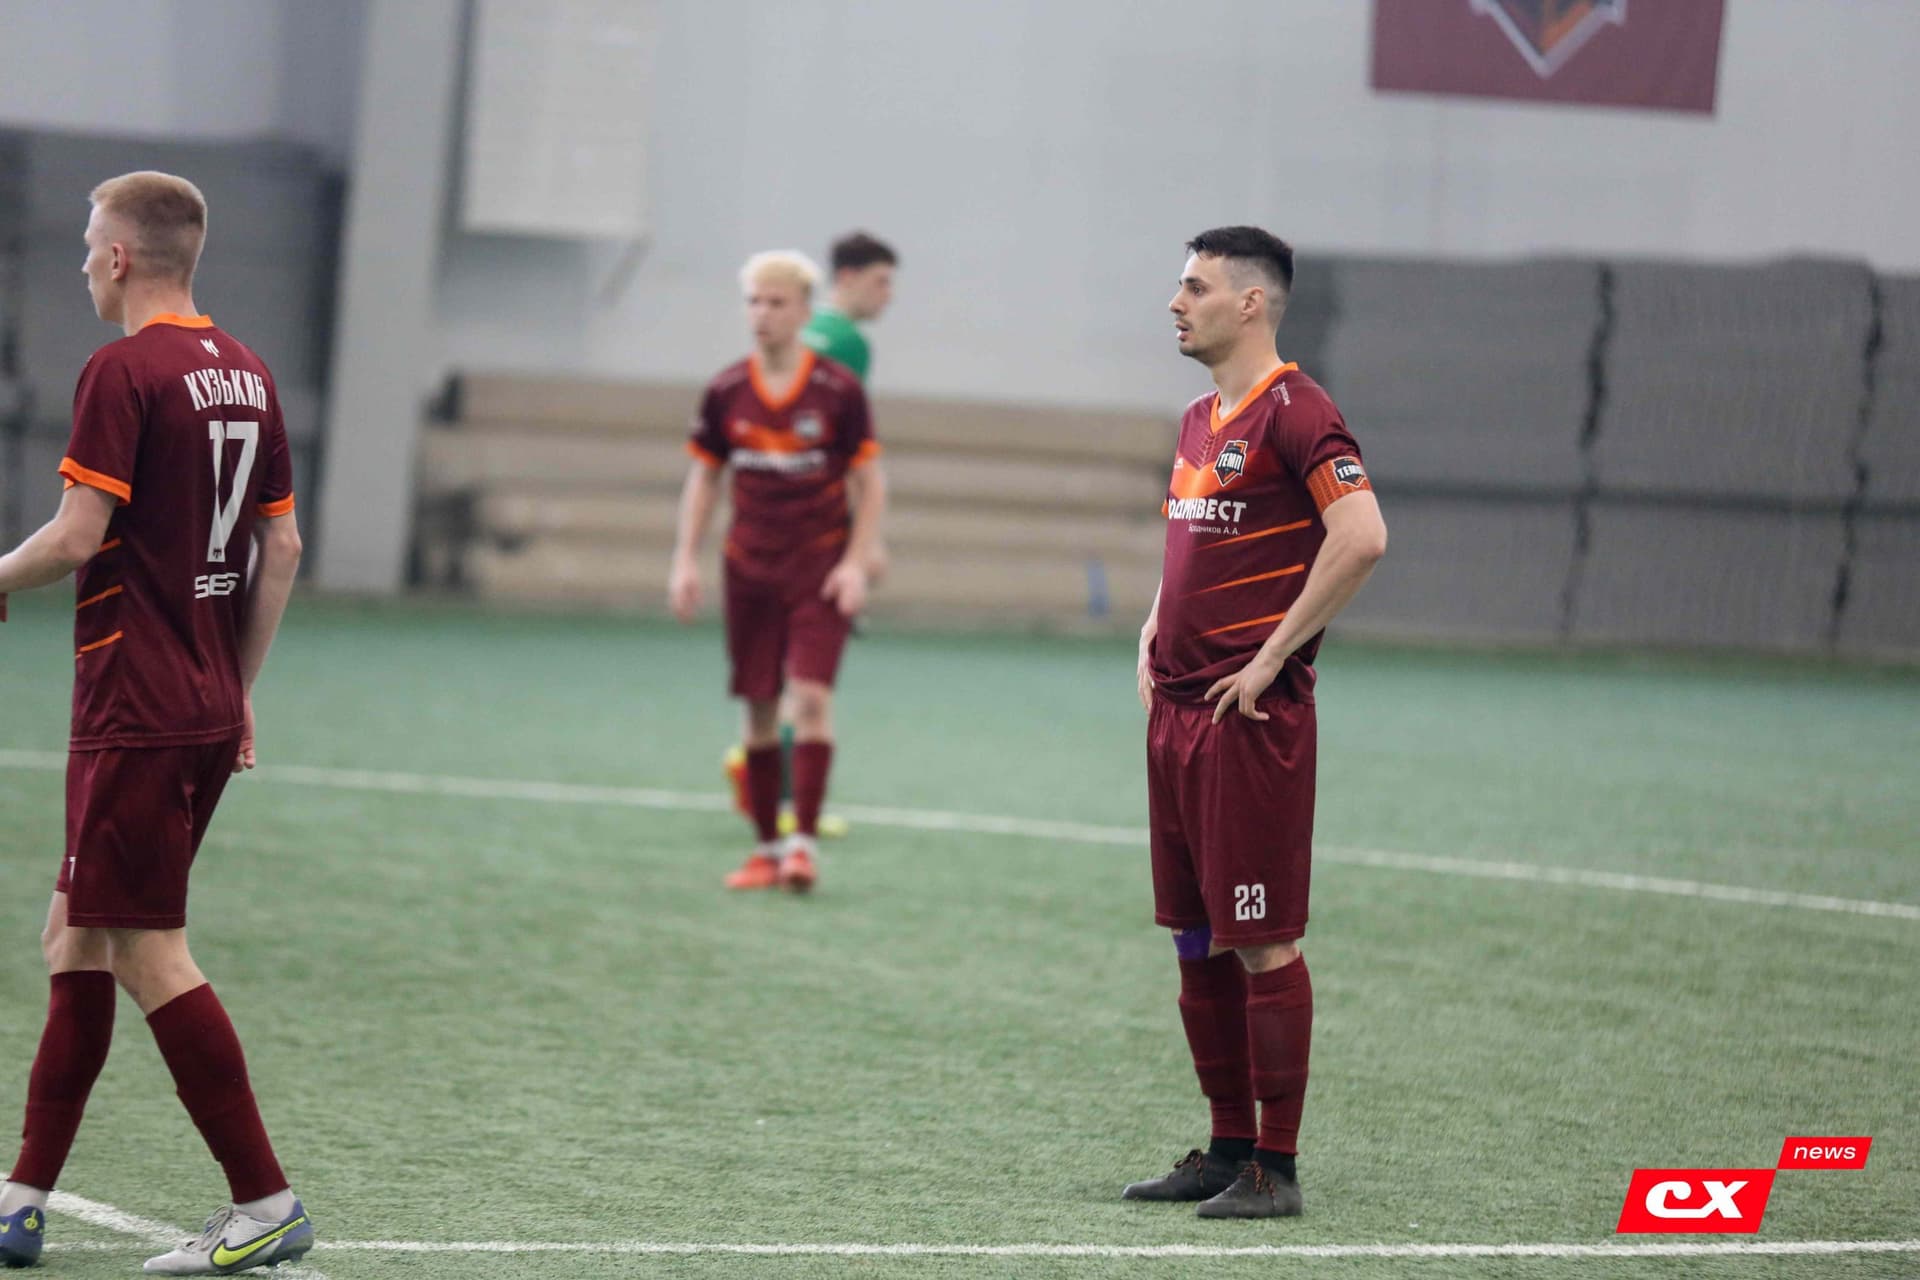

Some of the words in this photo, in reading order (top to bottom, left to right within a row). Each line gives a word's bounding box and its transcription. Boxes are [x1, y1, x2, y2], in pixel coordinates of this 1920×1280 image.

[183, 368, 267, 411] КУЗЬКИН
[207, 420, 259, 562] 17
[1235, 883, 1266, 921] 23
